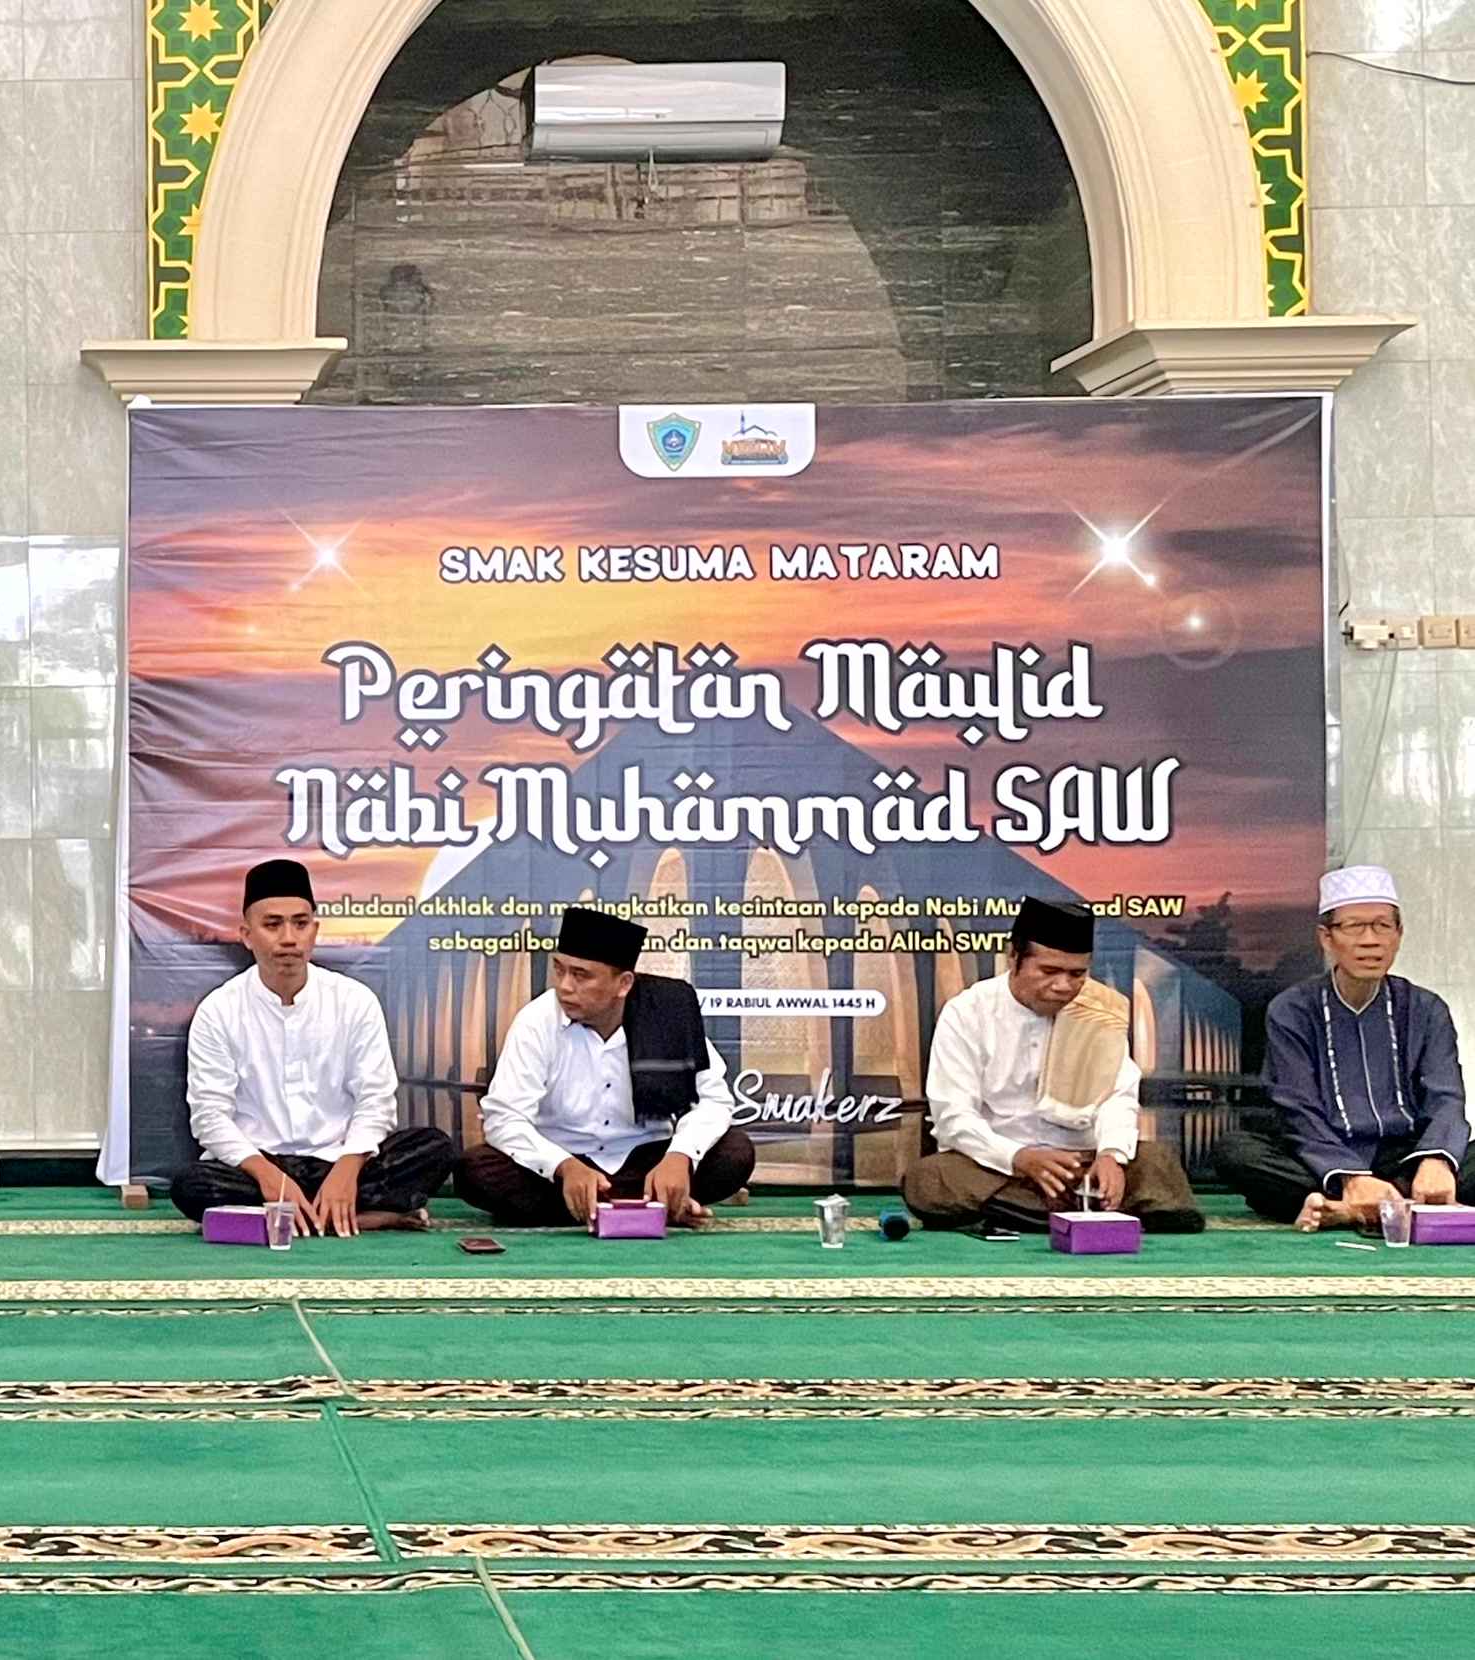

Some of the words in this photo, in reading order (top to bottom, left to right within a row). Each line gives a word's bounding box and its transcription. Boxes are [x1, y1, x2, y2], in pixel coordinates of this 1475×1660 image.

[439, 546, 565, 583] SMAK
[578, 544, 756, 582] KESUMA
[769, 543, 1001, 581] MATARAM
[994, 756, 1181, 853] SAW
[316, 895, 414, 916] neladani
[420, 895, 495, 916] akhlak
[500, 895, 543, 916] dan
[715, 896, 827, 917] kecintaan
[833, 896, 920, 922] kepada
[926, 896, 978, 917] Nabi
[1127, 895, 1184, 917] SAW
[428, 930, 520, 956] sebagai
[669, 929, 713, 951] dan
[719, 932, 794, 957] taqwa
[799, 929, 887, 956] kepada
[891, 929, 949, 951] Allah
[710, 996, 723, 1009] 19
[726, 996, 772, 1009] RABIUL
[776, 996, 829, 1009] AWWAL
[832, 996, 862, 1009] 1445
[866, 996, 875, 1009] H
[730, 1067, 904, 1126] Smakerz
